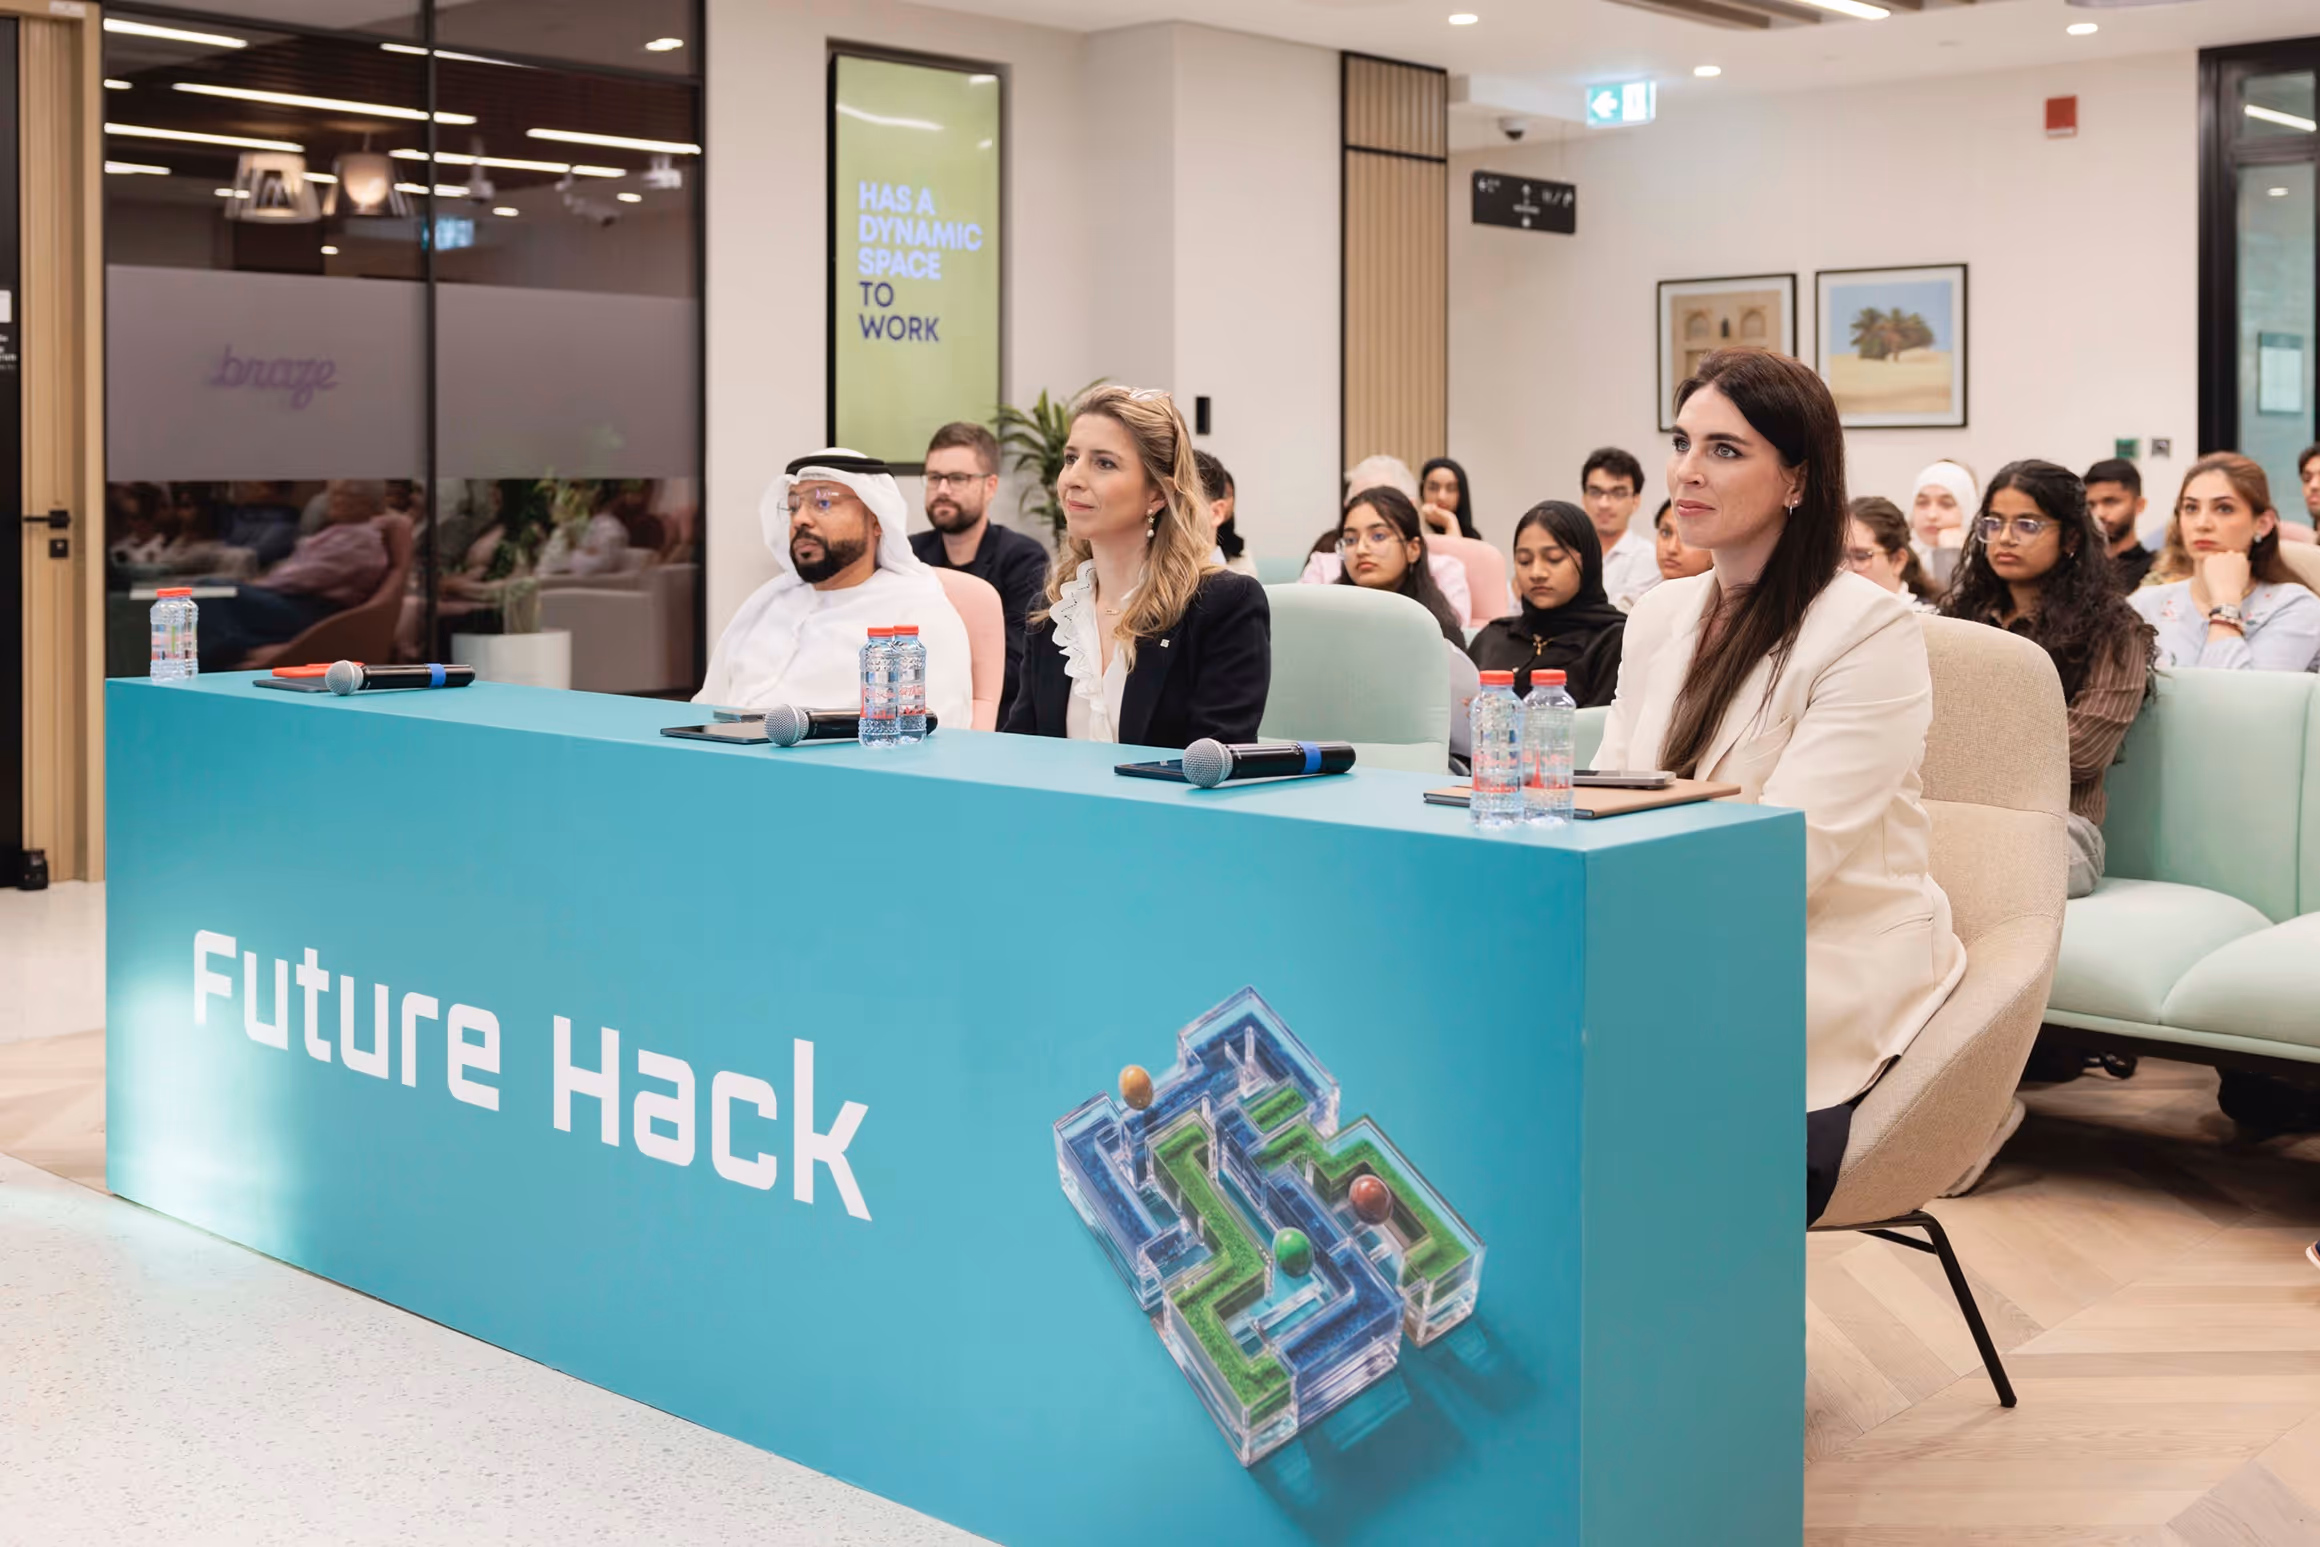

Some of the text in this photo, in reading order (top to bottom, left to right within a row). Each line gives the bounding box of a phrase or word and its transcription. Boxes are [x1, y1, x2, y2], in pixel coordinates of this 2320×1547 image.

[858, 180, 936, 216] HAS A
[858, 214, 983, 251] DYNAMIC
[858, 247, 942, 280] SPACE
[859, 281, 895, 308] TO
[858, 313, 939, 342] WORK
[211, 344, 338, 411] braze
[194, 929, 872, 1221] Future Hack
